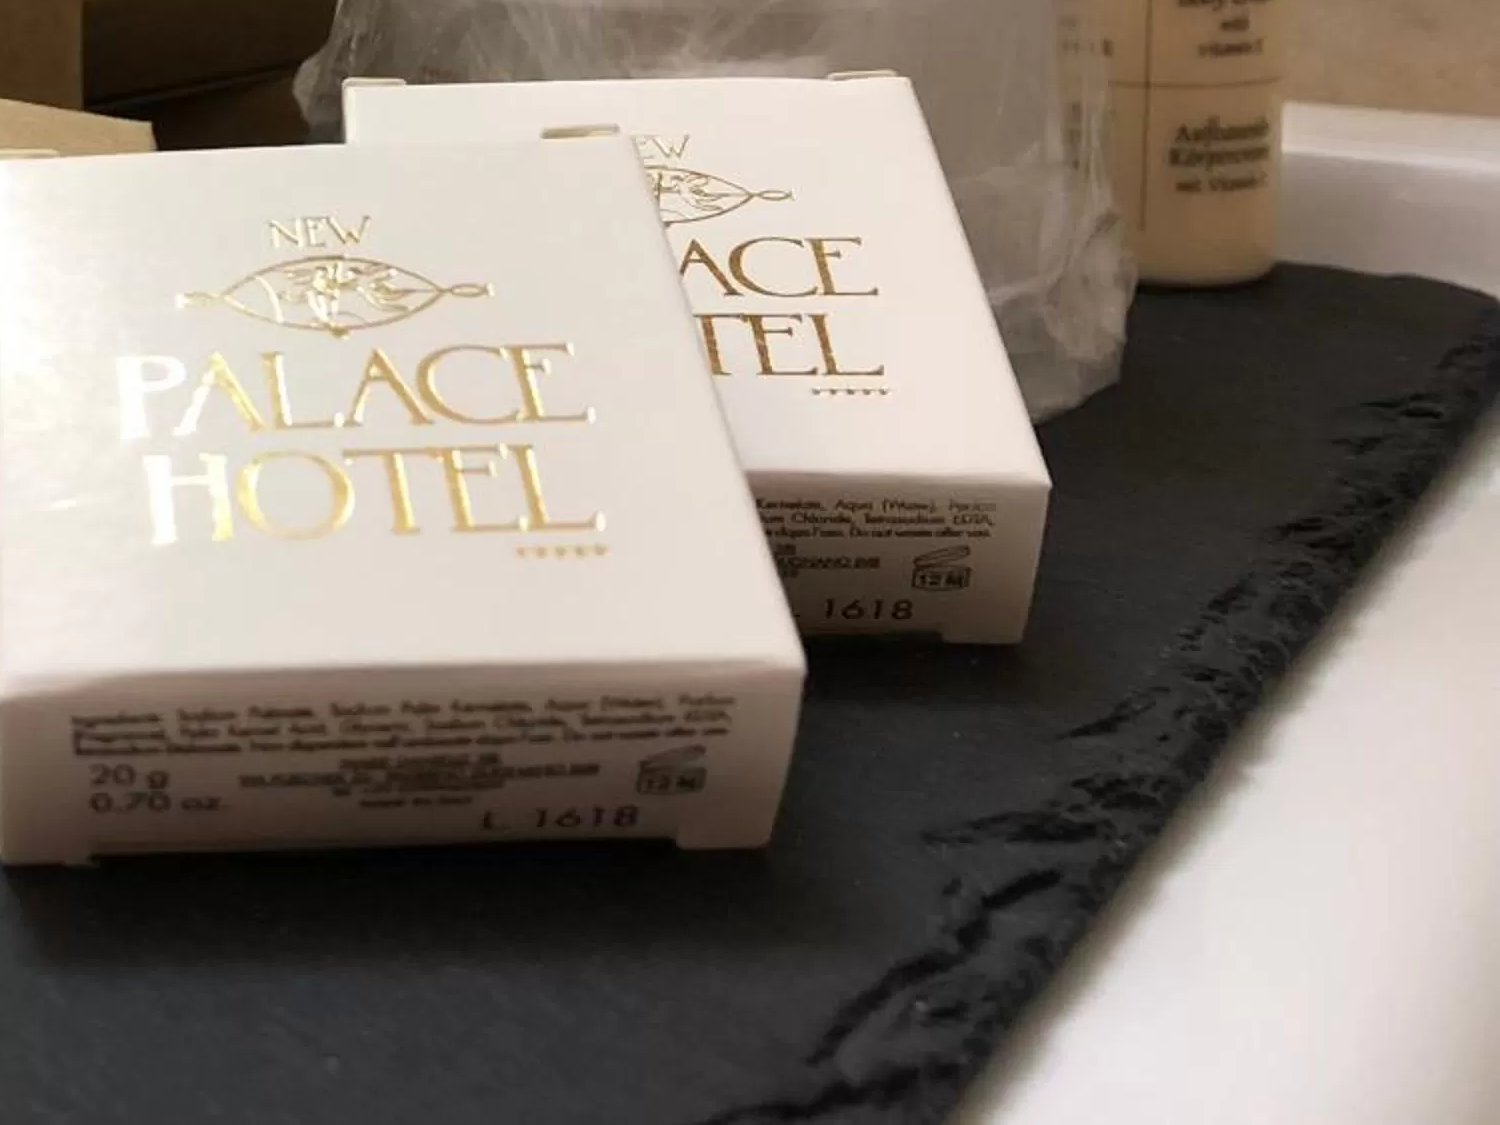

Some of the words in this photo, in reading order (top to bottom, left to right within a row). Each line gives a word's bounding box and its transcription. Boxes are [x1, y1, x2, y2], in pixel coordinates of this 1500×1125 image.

[268, 215, 371, 248] NEW
[678, 236, 879, 298] ACE
[692, 313, 886, 377] TEL
[114, 342, 598, 445] PALACE
[141, 443, 608, 547] HOTEL
[823, 597, 915, 621] 1618
[88, 762, 137, 787] 20
[145, 770, 170, 790] g
[88, 791, 173, 815] 0.70
[533, 803, 641, 829] 1618
